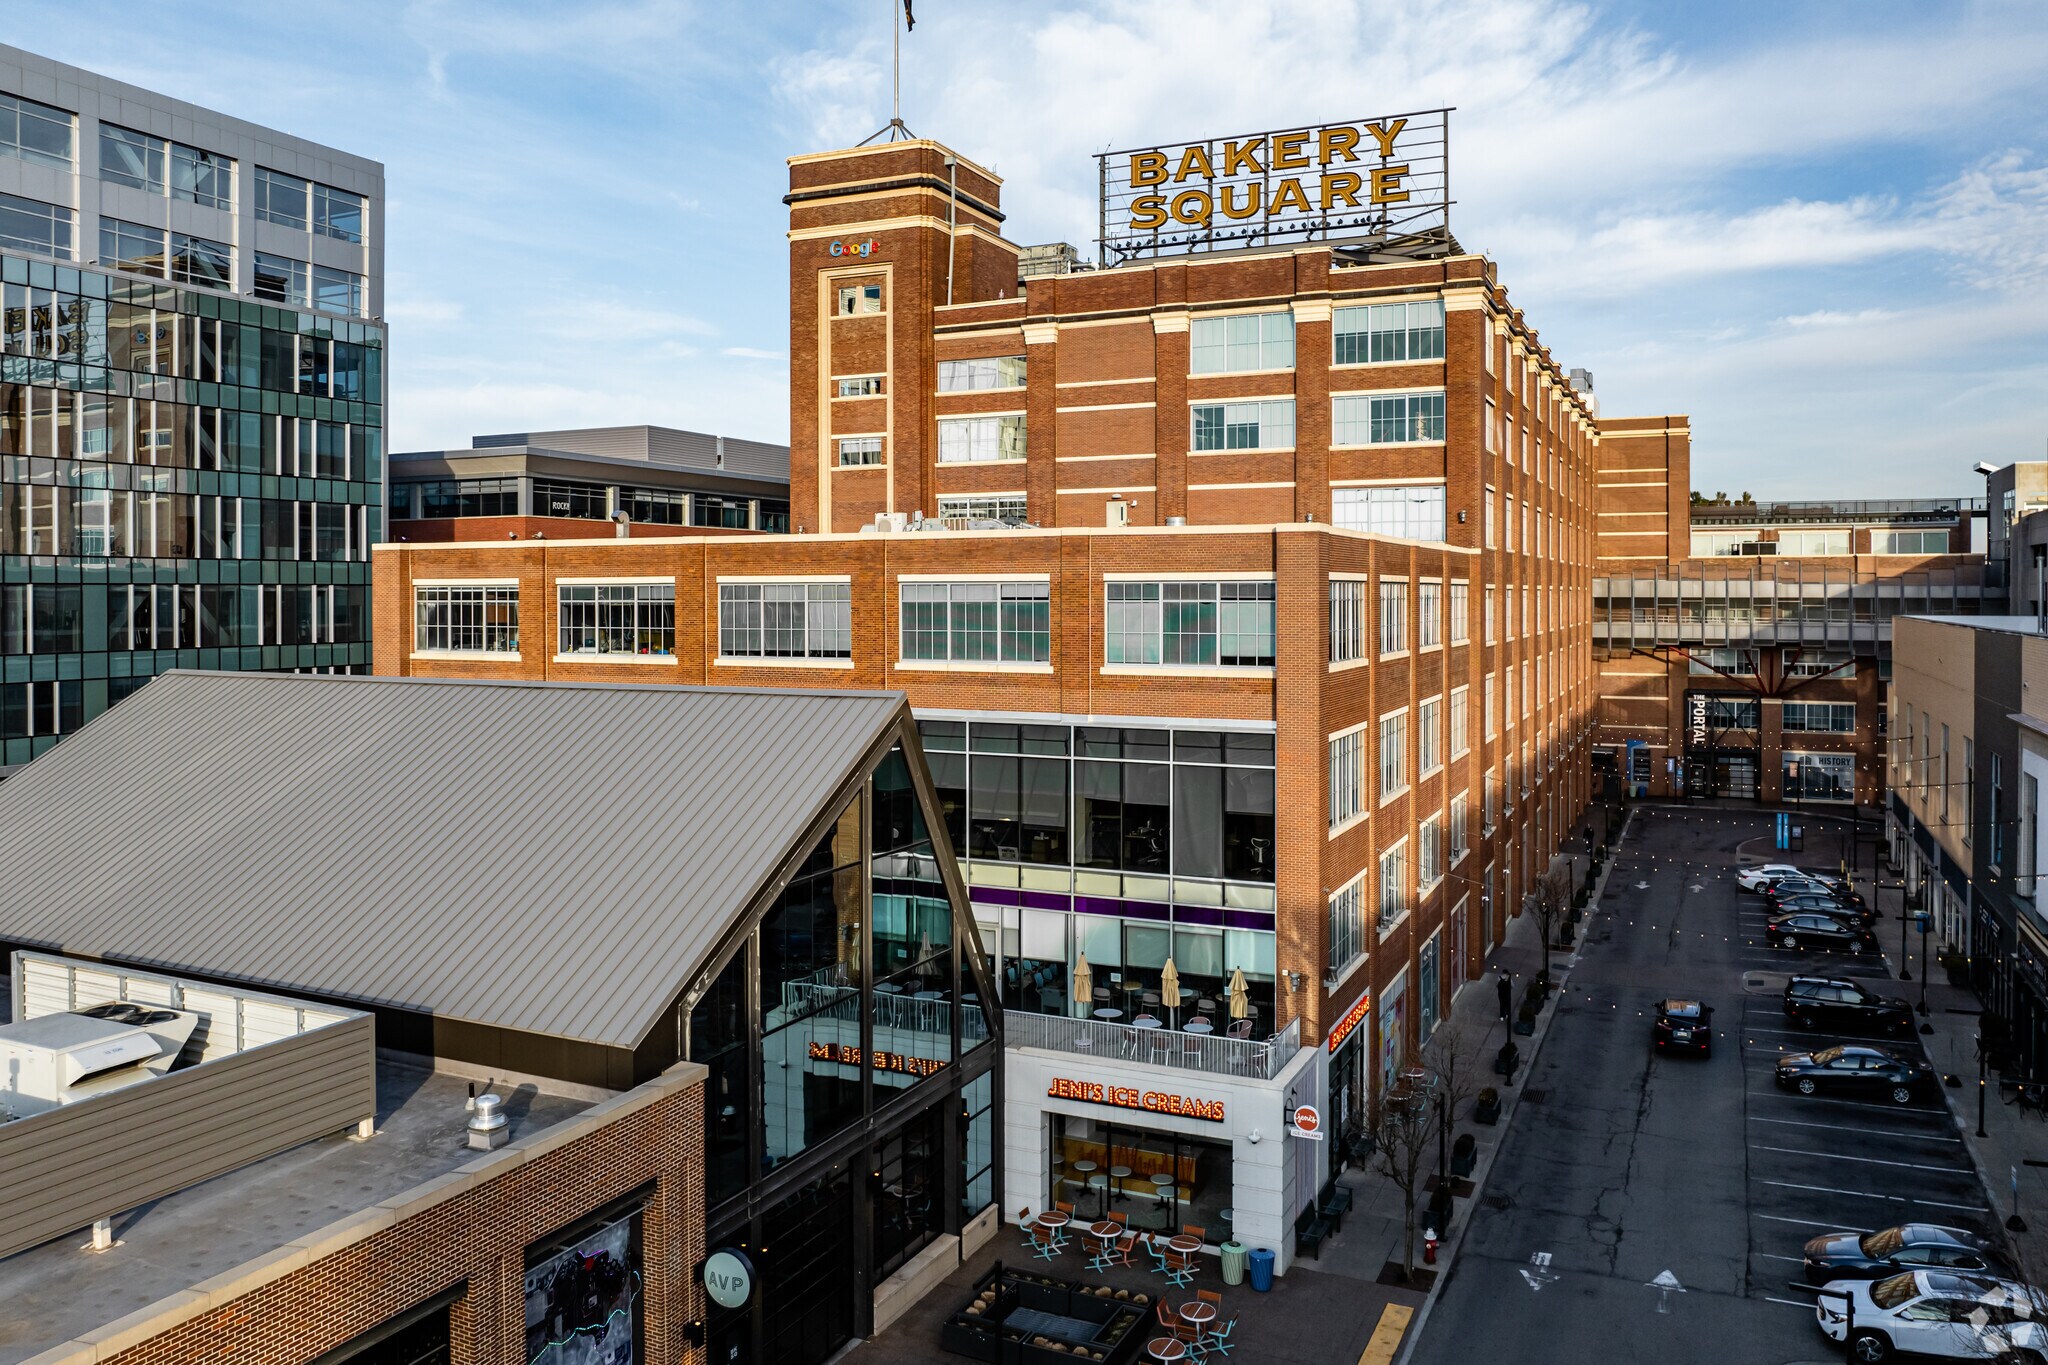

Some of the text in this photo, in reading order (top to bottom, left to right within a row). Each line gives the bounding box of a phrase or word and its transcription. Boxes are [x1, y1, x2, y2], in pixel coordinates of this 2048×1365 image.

[1130, 119, 1408, 188] BAKERY
[1129, 164, 1410, 230] SQUARE
[829, 238, 881, 258] Google
[1693, 700, 1706, 745] PORTAL
[1818, 757, 1851, 766] HISTORY
[1048, 1078, 1224, 1120] JENI'S ICE CREAMS
[708, 1271, 744, 1292] AVP
